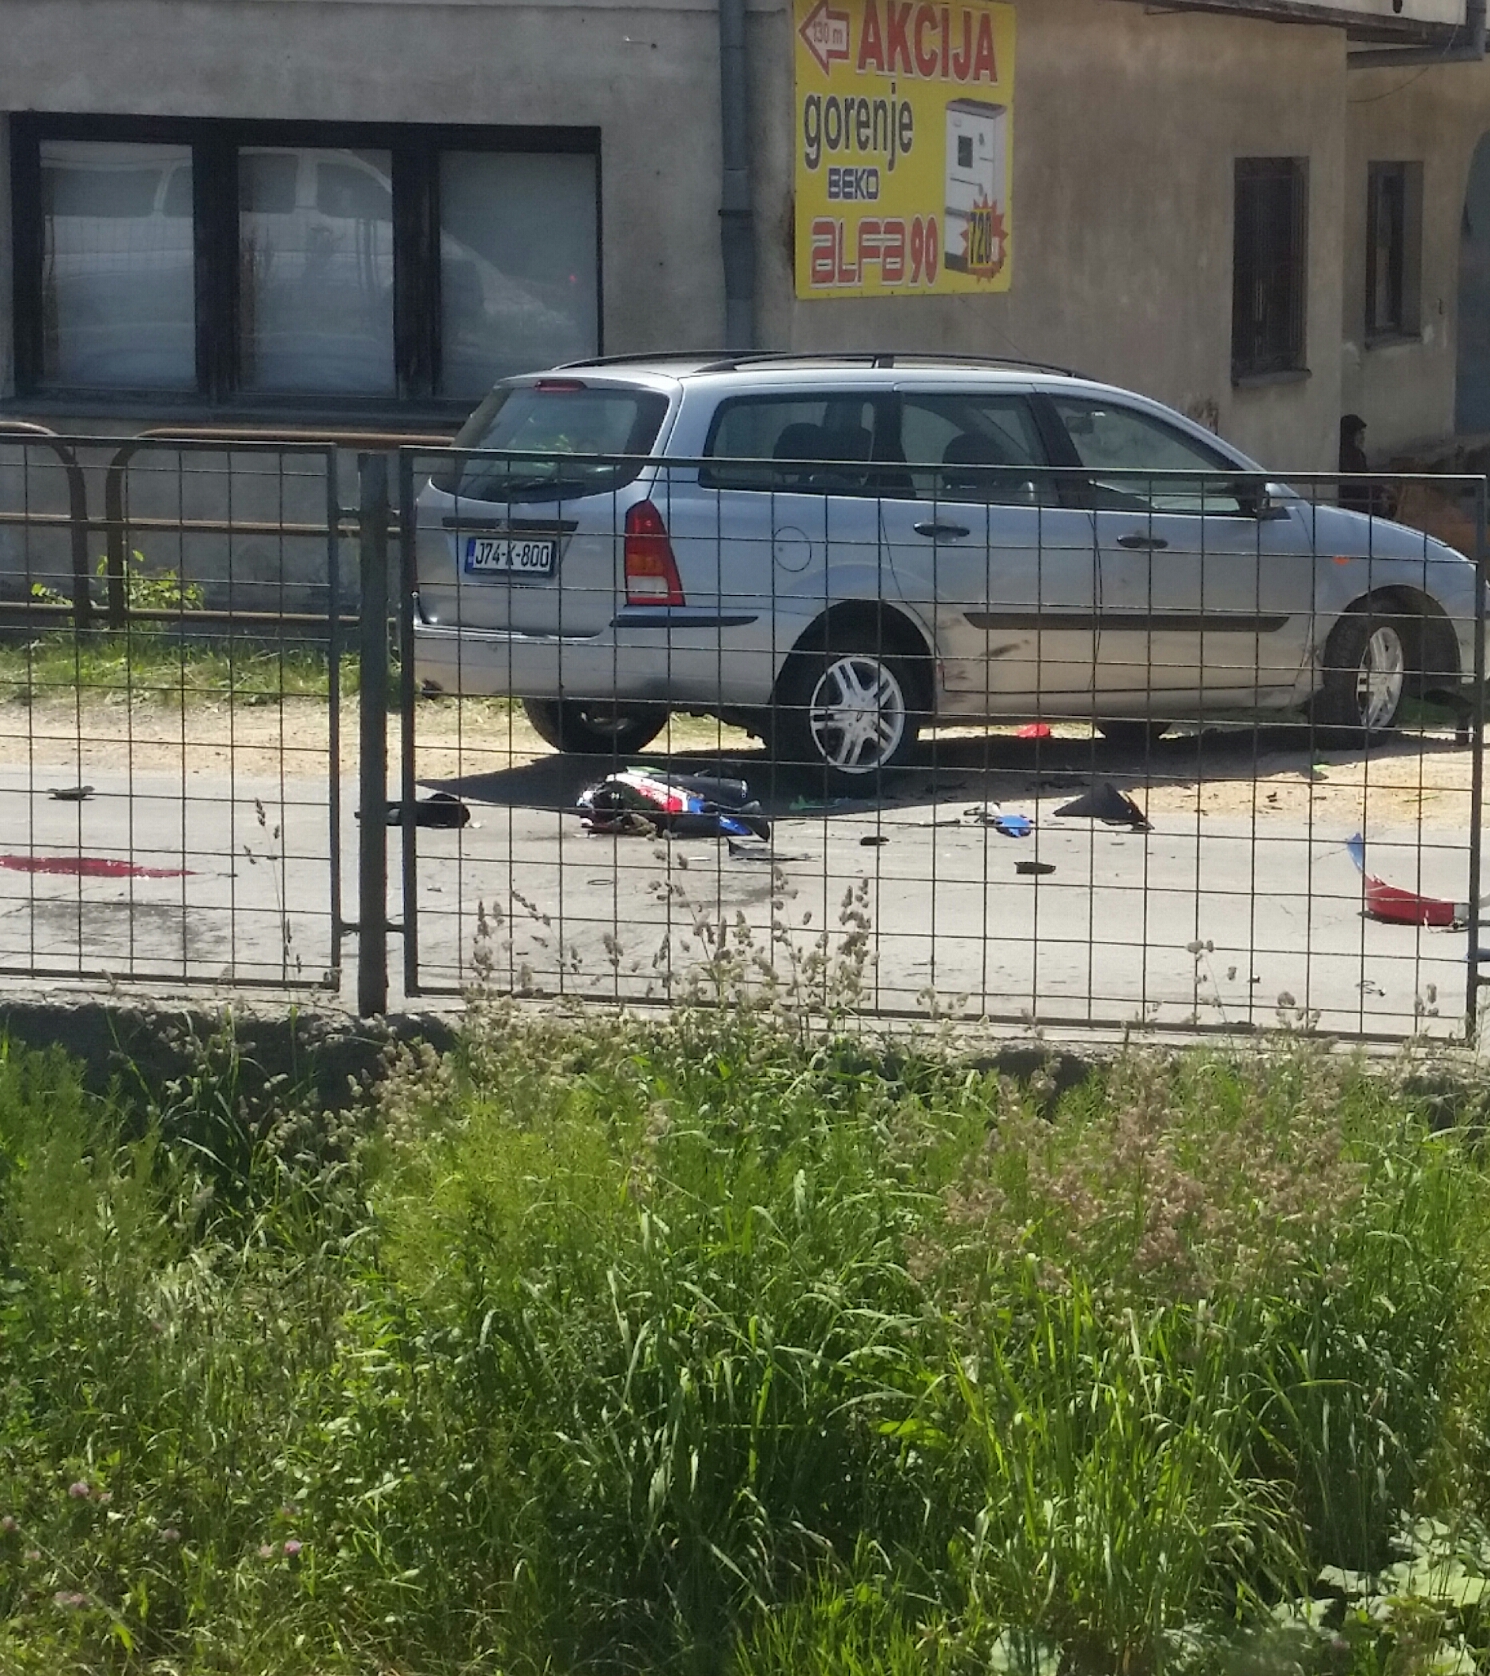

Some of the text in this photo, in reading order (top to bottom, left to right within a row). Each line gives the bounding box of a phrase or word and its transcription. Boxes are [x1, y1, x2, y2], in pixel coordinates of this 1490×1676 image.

[856, 1, 999, 84] AKCIJA
[804, 82, 914, 171] gorenje
[828, 168, 879, 200] BEKO
[910, 217, 938, 284] 90
